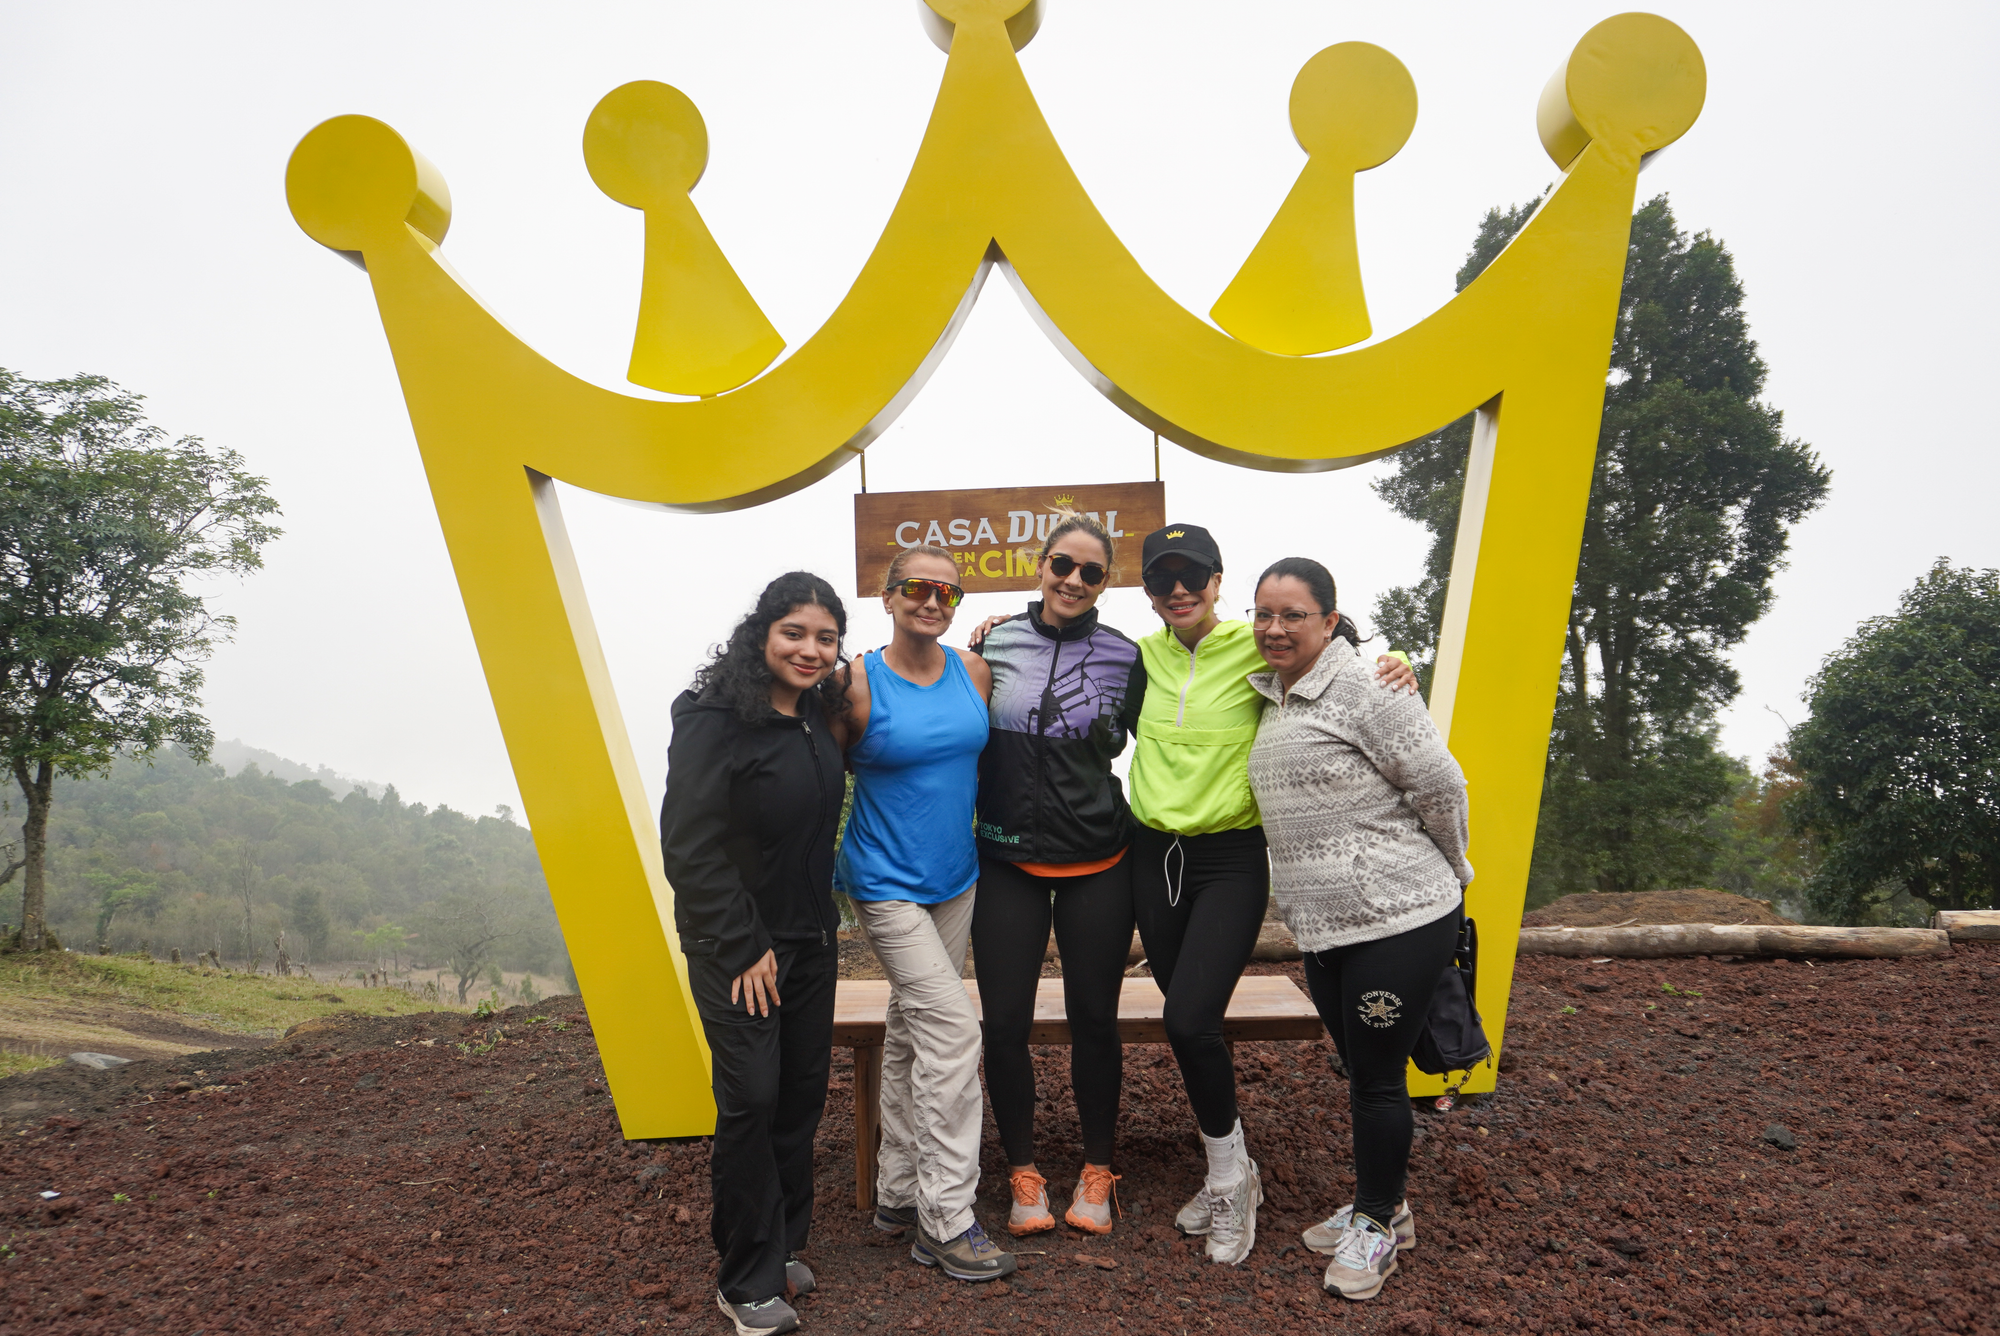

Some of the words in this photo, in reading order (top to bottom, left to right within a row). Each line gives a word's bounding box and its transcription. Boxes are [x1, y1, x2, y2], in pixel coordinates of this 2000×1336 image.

[895, 517, 999, 549] CASA
[1006, 510, 1124, 543] DUL
[953, 551, 976, 564] EN
[979, 547, 1043, 578] CIM
[959, 565, 977, 577] A
[980, 822, 1002, 834] TOKYO
[980, 830, 1020, 844] EXCLUSIVE
[1361, 990, 1403, 1007] CONVERSE
[1359, 1014, 1371, 1026] ALL
[1373, 1020, 1395, 1028] STAR
